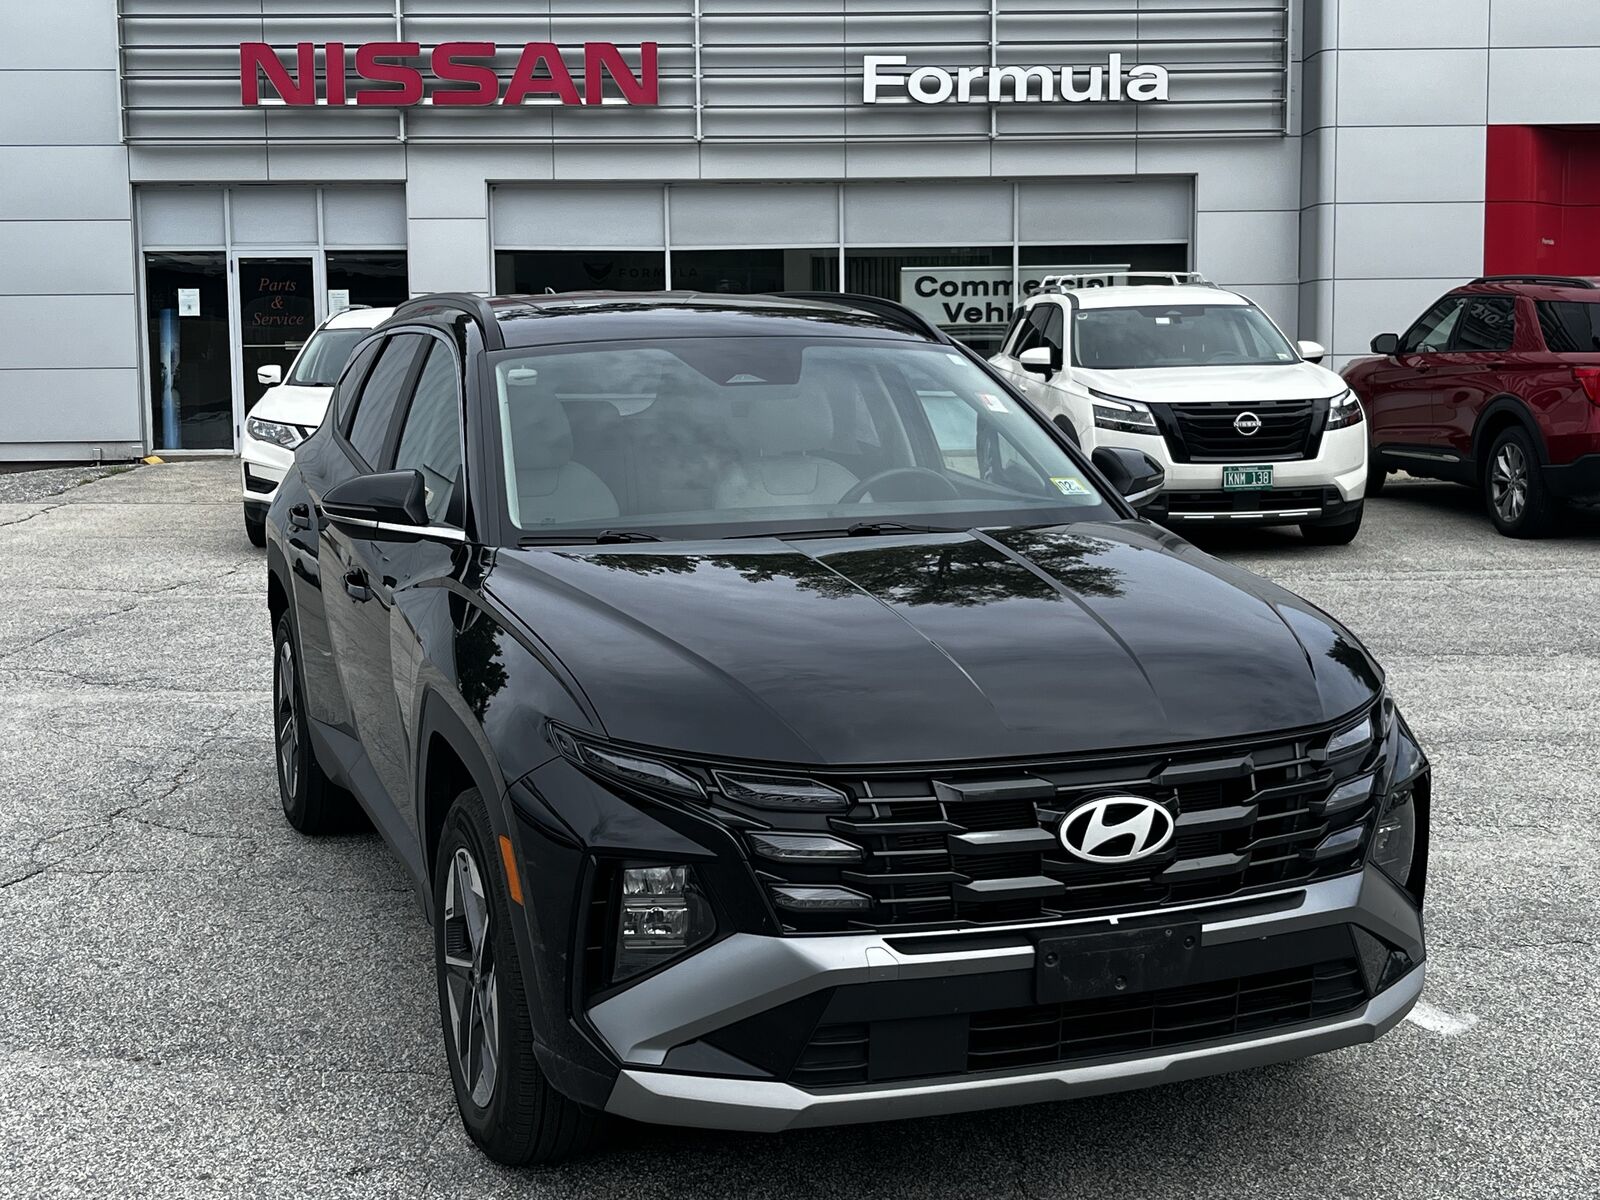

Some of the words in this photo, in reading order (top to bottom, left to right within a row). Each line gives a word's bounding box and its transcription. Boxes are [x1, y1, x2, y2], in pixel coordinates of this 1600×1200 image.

[240, 42, 659, 106] NISSAN
[863, 52, 1169, 104] Formula
[259, 278, 297, 291] Parts
[271, 296, 284, 309] &
[252, 312, 305, 326] Service
[1228, 472, 1246, 485] KNM
[1251, 471, 1270, 485] 138
